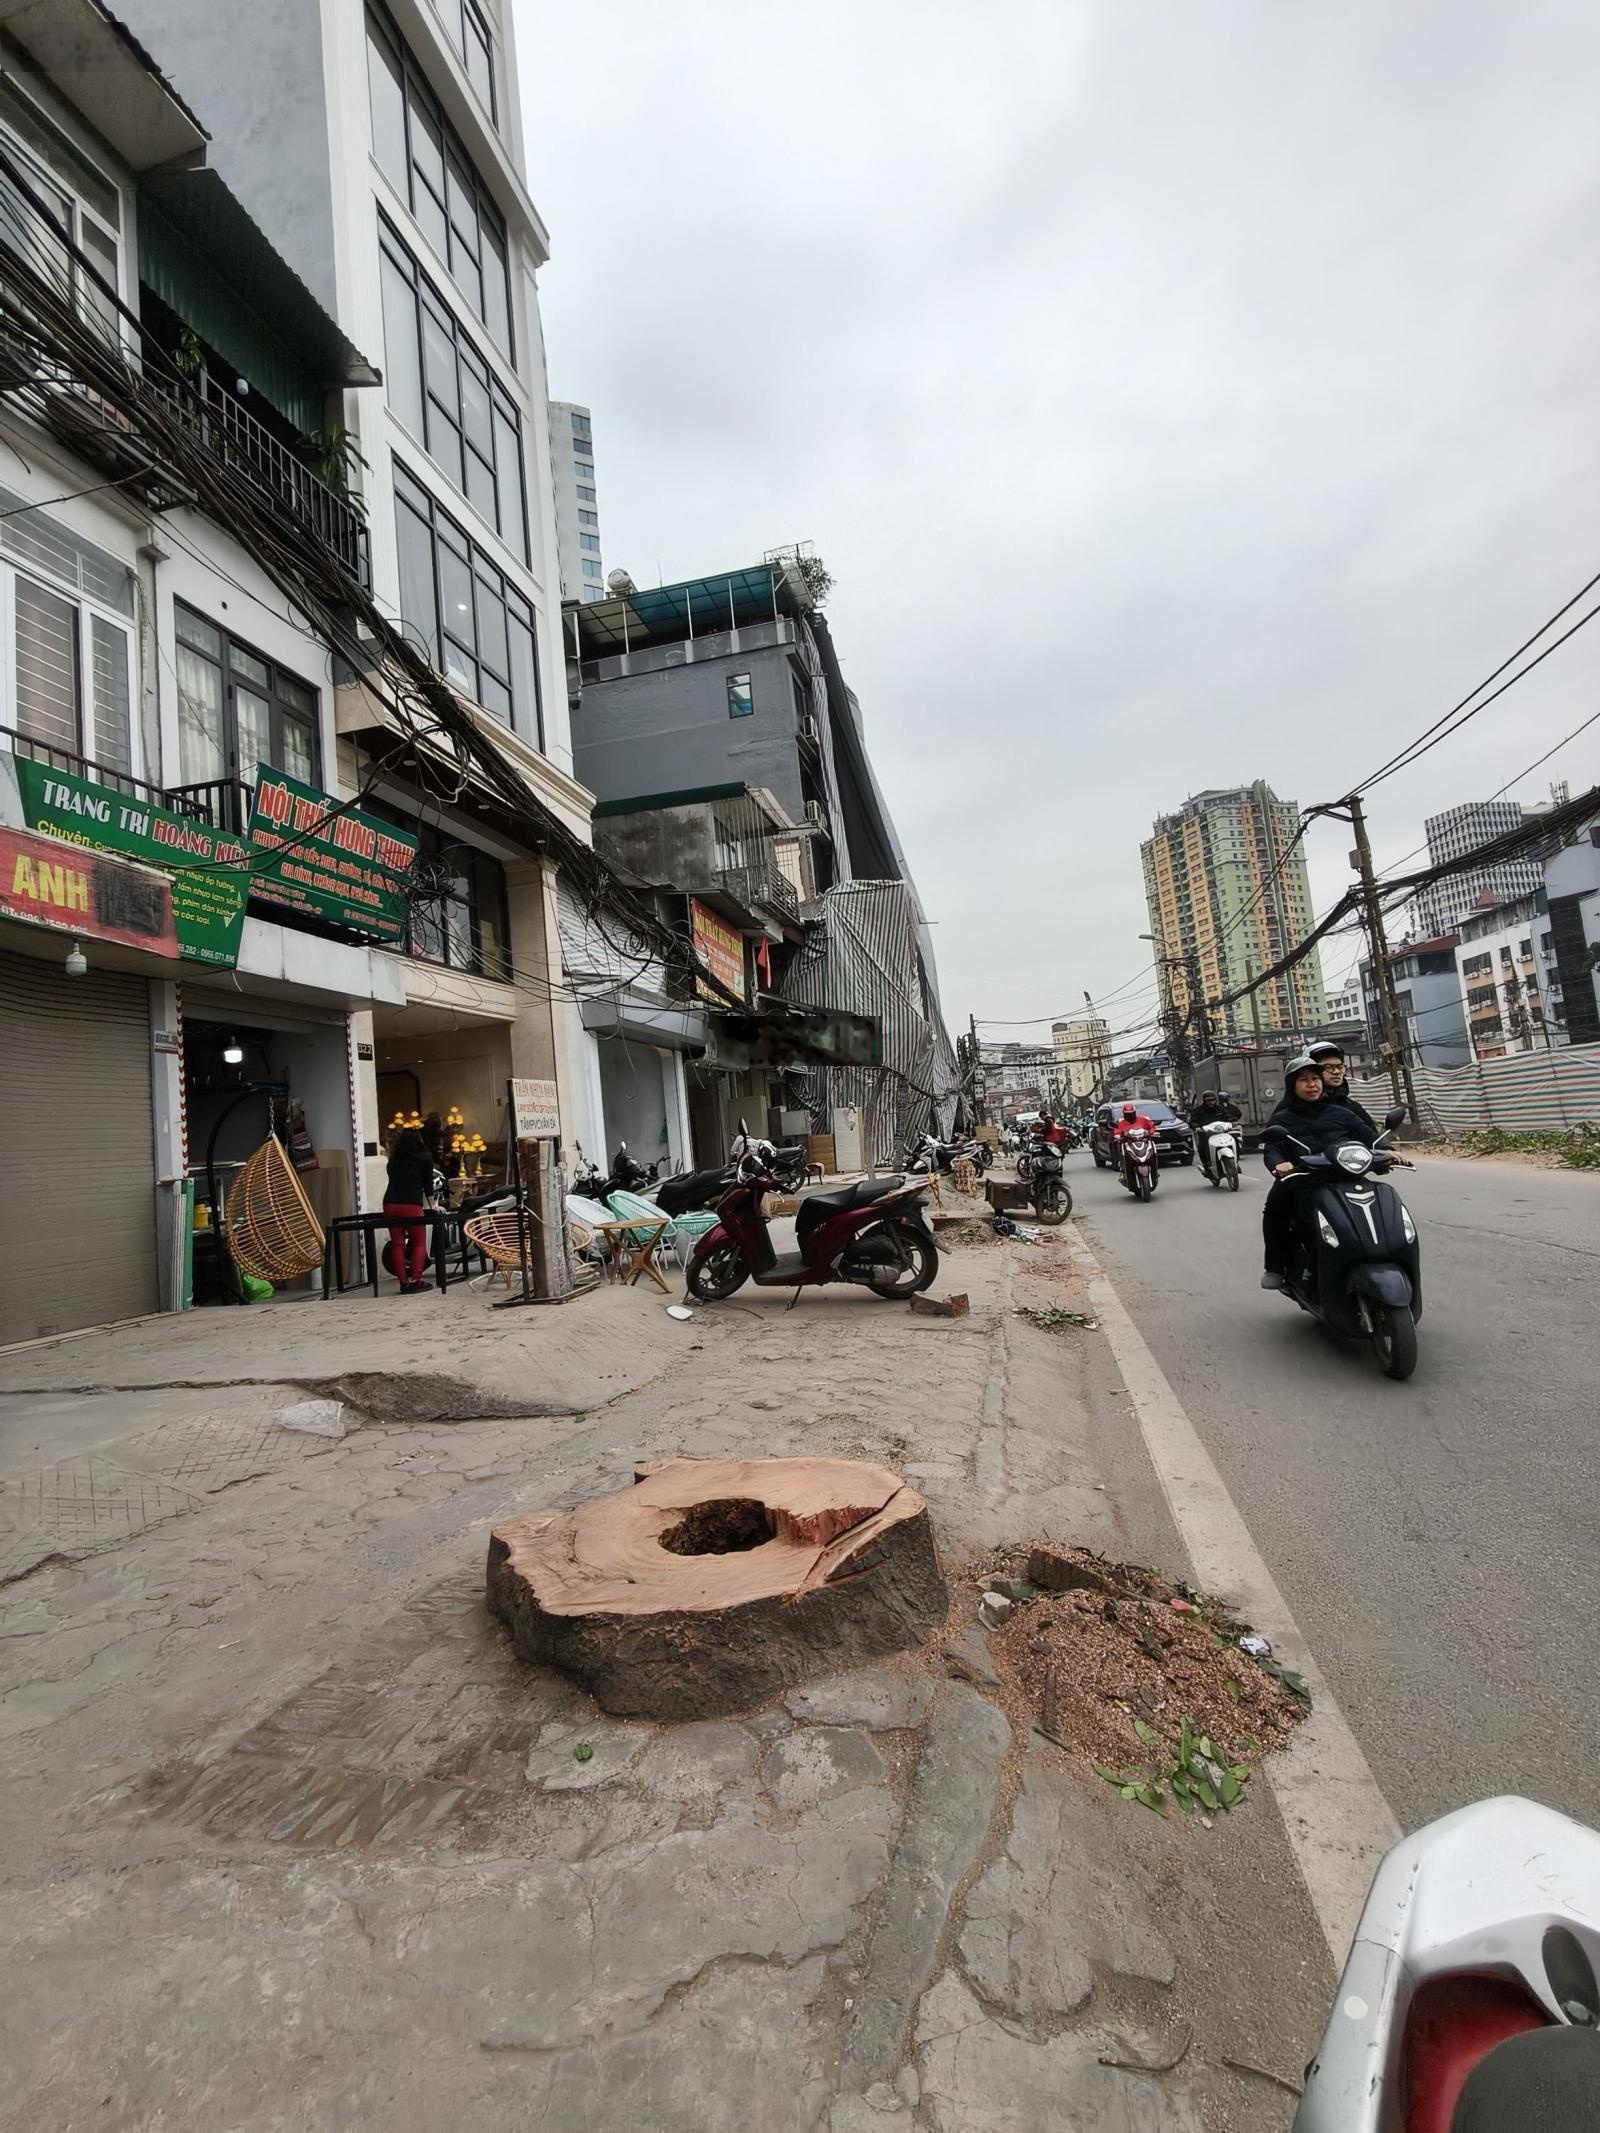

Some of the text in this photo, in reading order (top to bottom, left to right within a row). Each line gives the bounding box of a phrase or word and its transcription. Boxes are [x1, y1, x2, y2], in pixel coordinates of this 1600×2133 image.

[43, 779, 111, 823] TRANG
[119, 808, 151, 837] TRÍ
[257, 780, 294, 830] NỘI
[293, 797, 334, 843] THẤT
[333, 815, 376, 860] HƯNG
[12, 854, 88, 912] ANH
